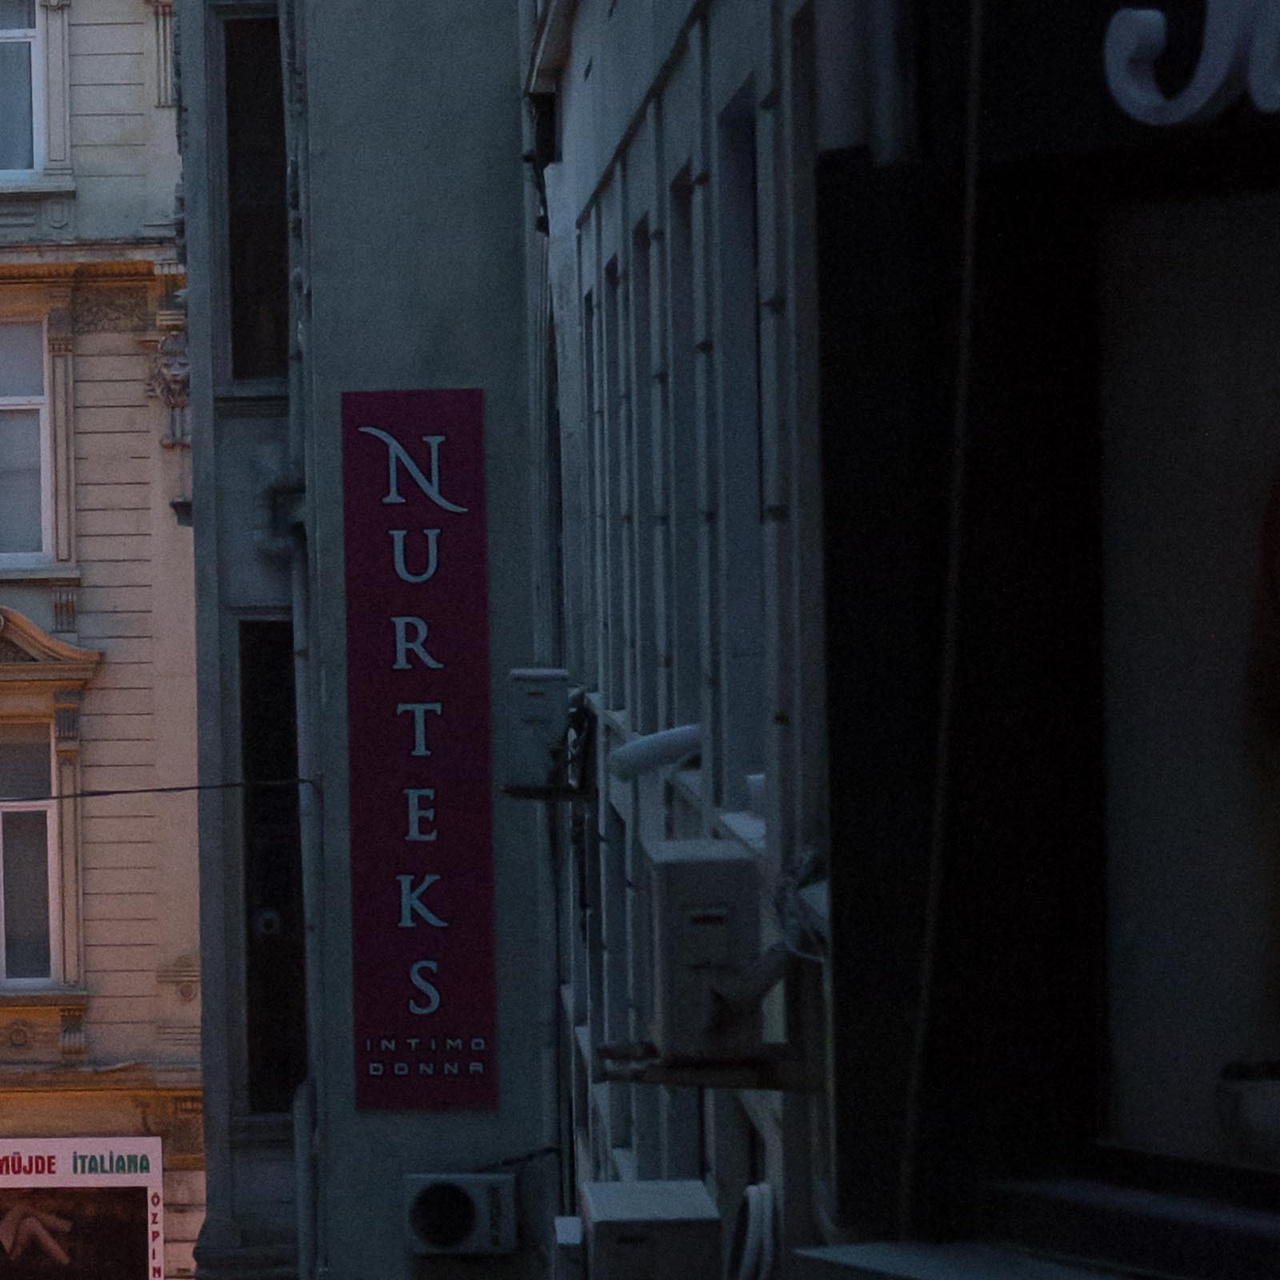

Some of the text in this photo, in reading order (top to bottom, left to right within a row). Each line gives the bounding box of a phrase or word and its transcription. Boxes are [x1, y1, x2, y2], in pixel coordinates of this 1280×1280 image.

[358, 426, 469, 1016] NURTEKS
[365, 1037, 486, 1052] INTIMO
[368, 1061, 484, 1076] DONNA
[72, 1150, 151, 1175] İTALİANA
